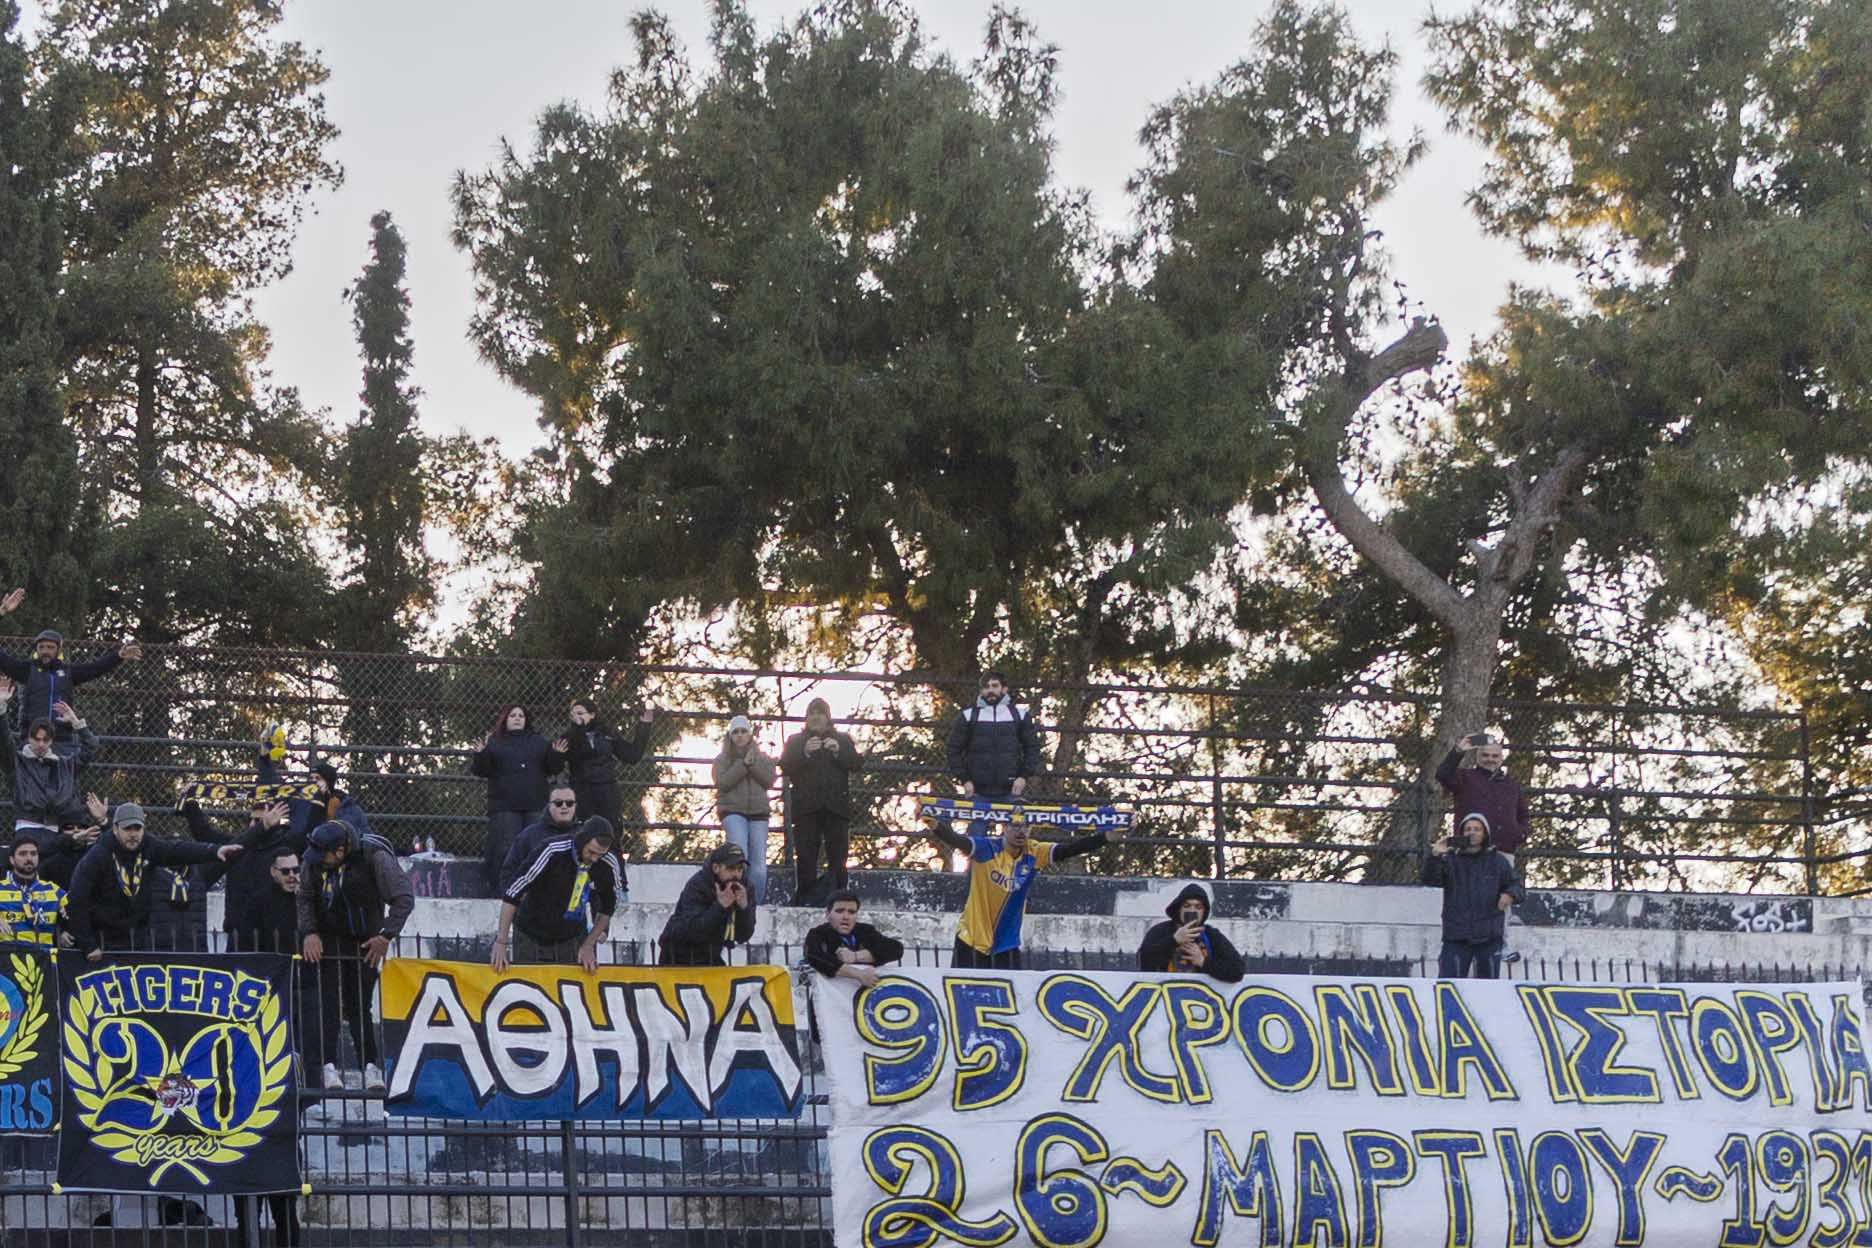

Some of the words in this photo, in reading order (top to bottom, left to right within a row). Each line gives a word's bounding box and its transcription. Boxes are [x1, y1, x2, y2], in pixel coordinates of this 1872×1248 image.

[195, 782, 320, 801] IGERS
[920, 805, 1011, 822] ΑΣΤΕΡΑΣ
[1024, 810, 1130, 826] ΤΡΙΠΟΛΗΣ
[75, 964, 272, 1023] TIGERS
[386, 971, 805, 1116] ΑΘΗΝΑ
[853, 975, 1028, 1112] 95
[1036, 973, 1521, 1105] ΧΡΟΝΙΑ
[1515, 984, 1872, 1114] ΙΣΤΟΡΙΑ
[91, 1017, 265, 1136] 20
[134, 1133, 219, 1167] years
